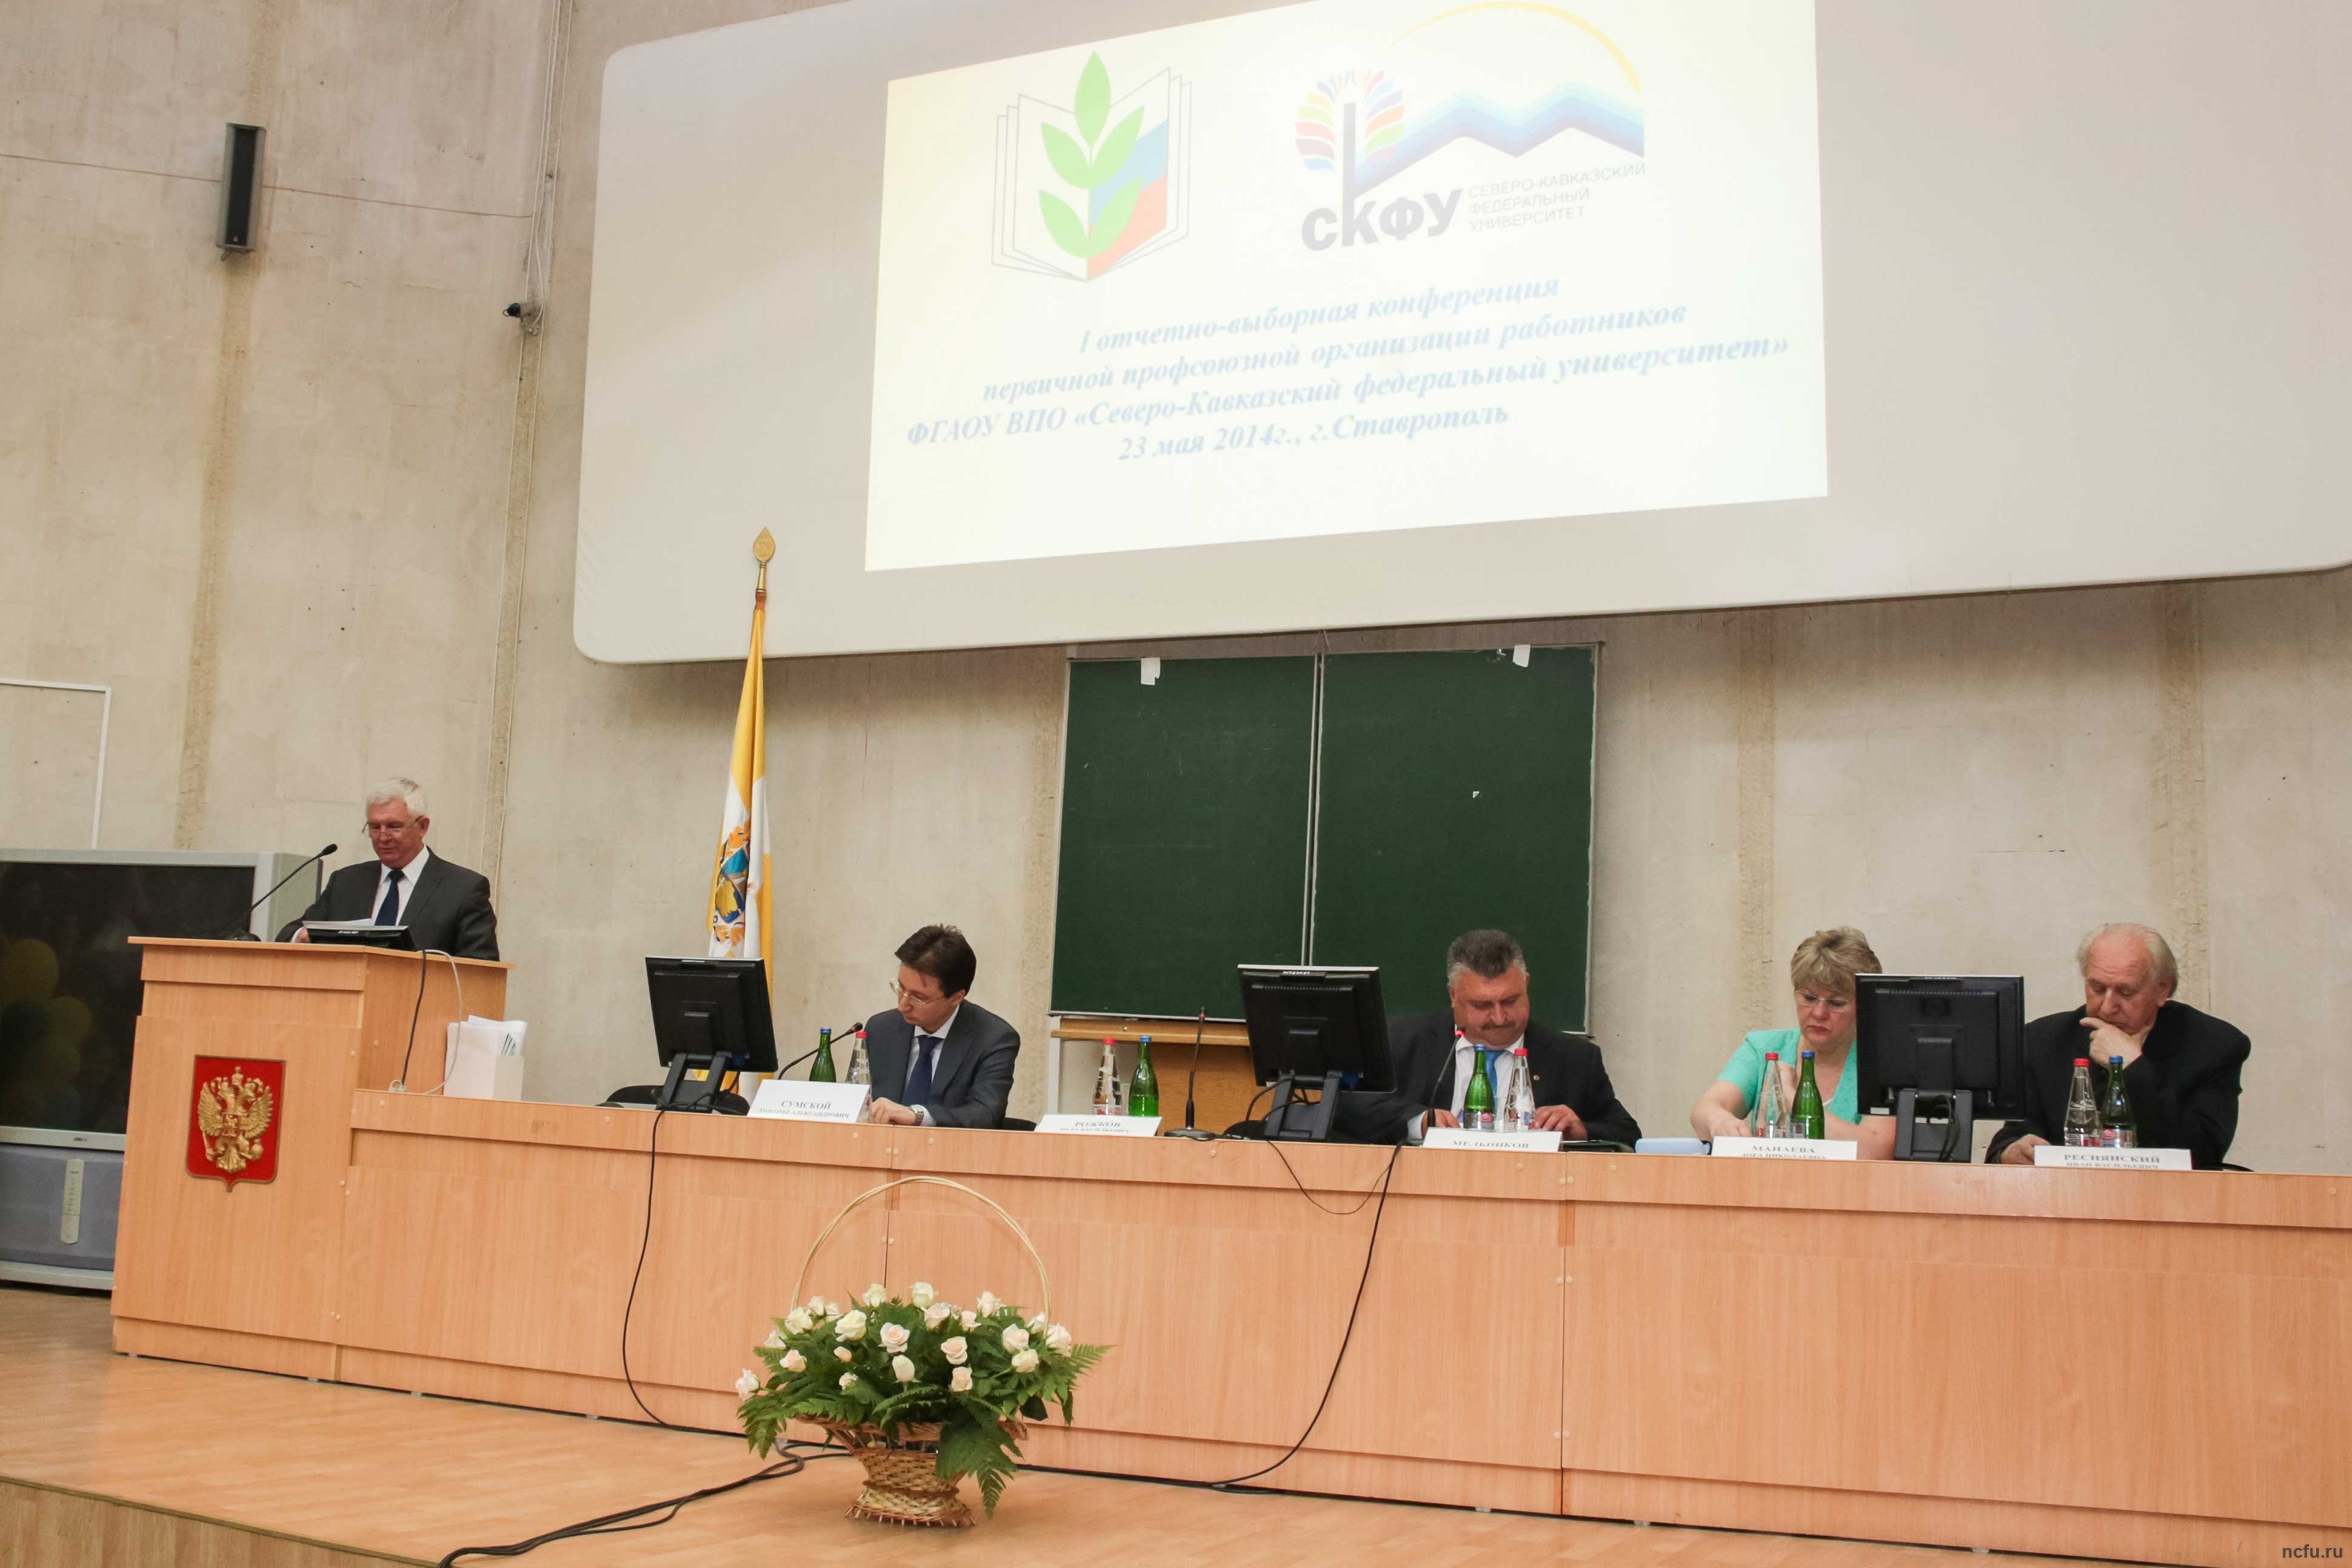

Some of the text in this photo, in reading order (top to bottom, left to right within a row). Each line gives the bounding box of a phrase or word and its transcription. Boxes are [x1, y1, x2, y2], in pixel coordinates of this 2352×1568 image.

[1468, 162, 1646, 198] СЕВЕРО-КАВКАЗСКИЙ
[1469, 187, 1591, 215] ФЕДЕРАЛЬНЫЙ
[1301, 184, 1463, 252] СКФУ
[1469, 205, 1586, 232] УНИВЕРСИТЕТ
[1096, 302, 1358, 350] отчетно-выборная
[1368, 278, 1560, 319] конференция
[983, 304, 1687, 402] первичной профсоюзной организации работников
[908, 336, 1789, 444] ФГАОУ ВПО «Северо-Кавказский федеральный университет»
[1118, 436, 1147, 460] 23
[1152, 433, 1204, 456] мая
[781, 1100, 832, 1110] СУМСКОЙ
[1451, 1140, 1530, 1149] МЕЛЬНИКОВ
[1752, 1145, 1816, 1154] МАНАЕВА
[2063, 1153, 2160, 1164] РЕСНЯНСКИЙ
